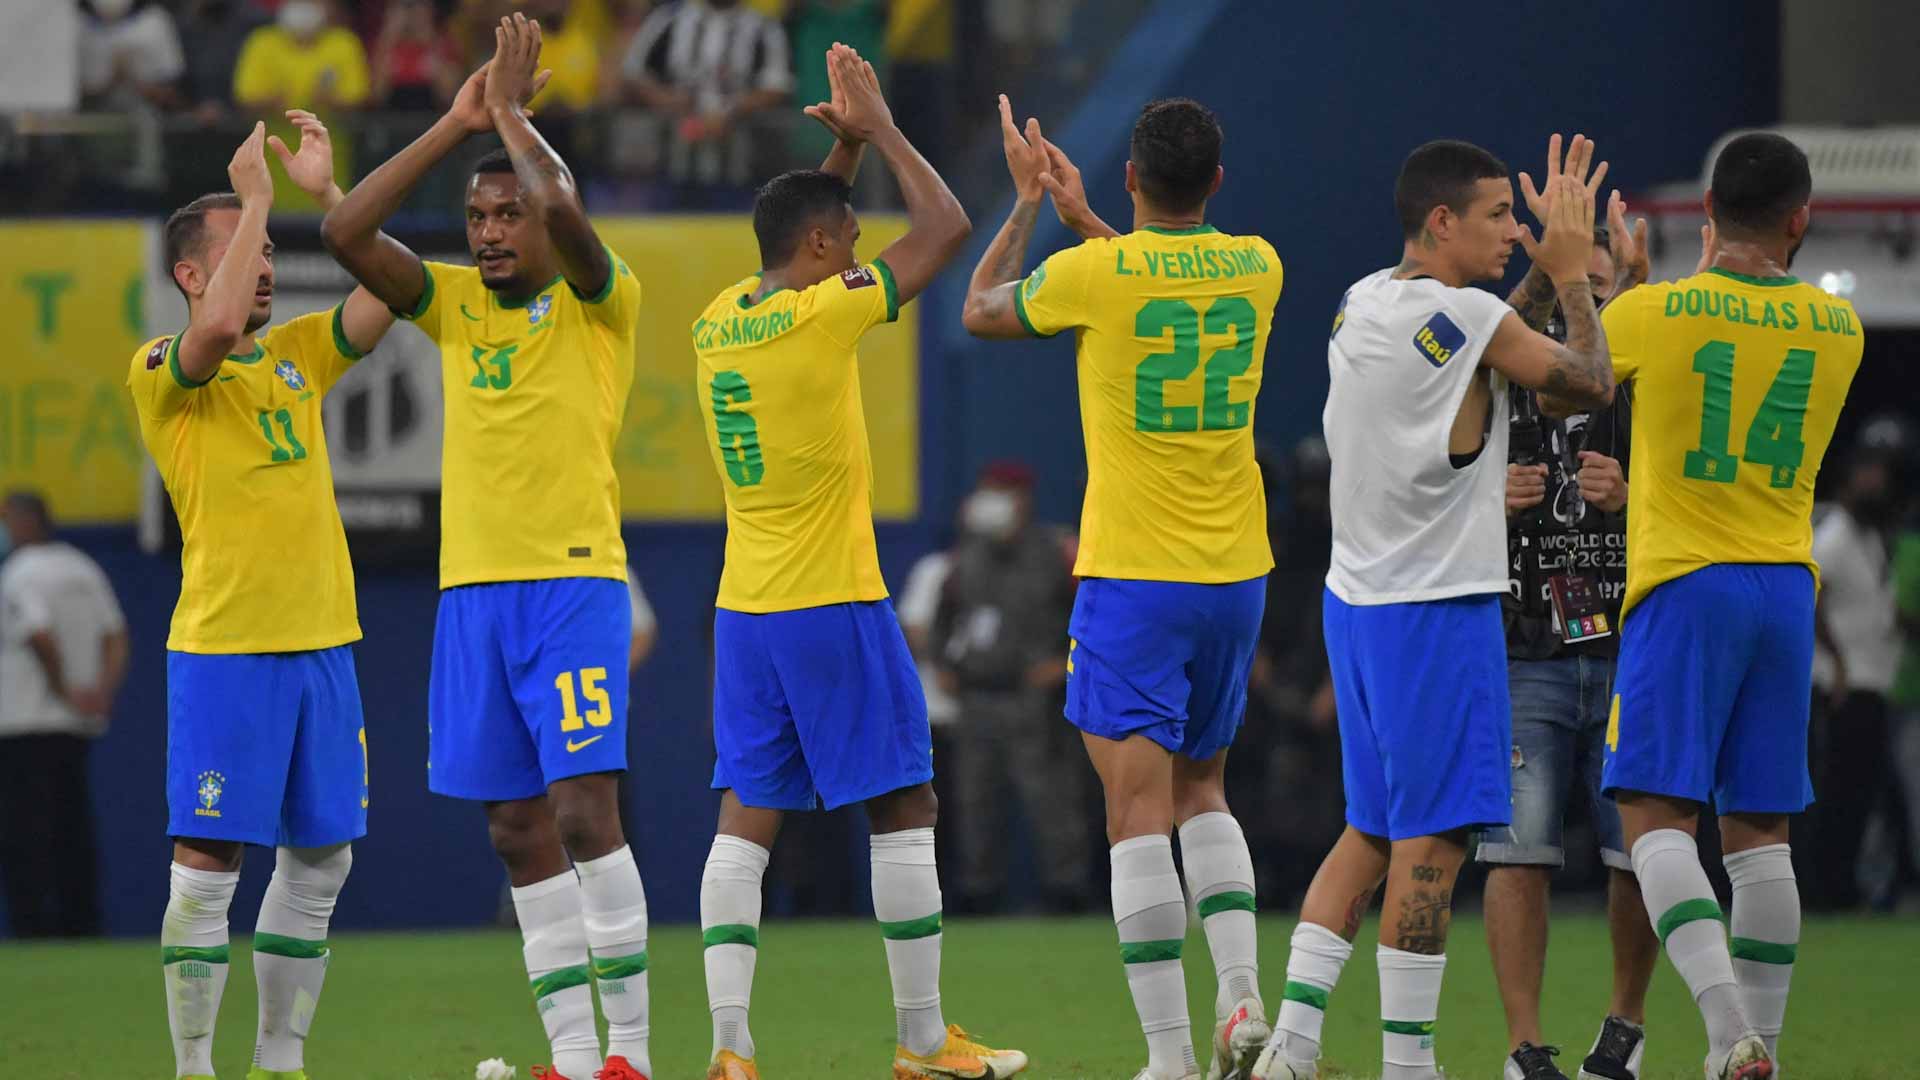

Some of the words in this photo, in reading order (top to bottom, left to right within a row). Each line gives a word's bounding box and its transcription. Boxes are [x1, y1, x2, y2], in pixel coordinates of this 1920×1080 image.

[720, 309, 794, 347] SANDRO
[1664, 288, 1799, 330] DOUGLAS
[1808, 303, 1857, 336] LUIZ
[1134, 296, 1257, 433] 22
[1416, 326, 1451, 364] Itaú
[258, 408, 307, 462] 11
[710, 370, 765, 487] 6
[1682, 339, 1817, 489] 14
[554, 666, 613, 733] 15
